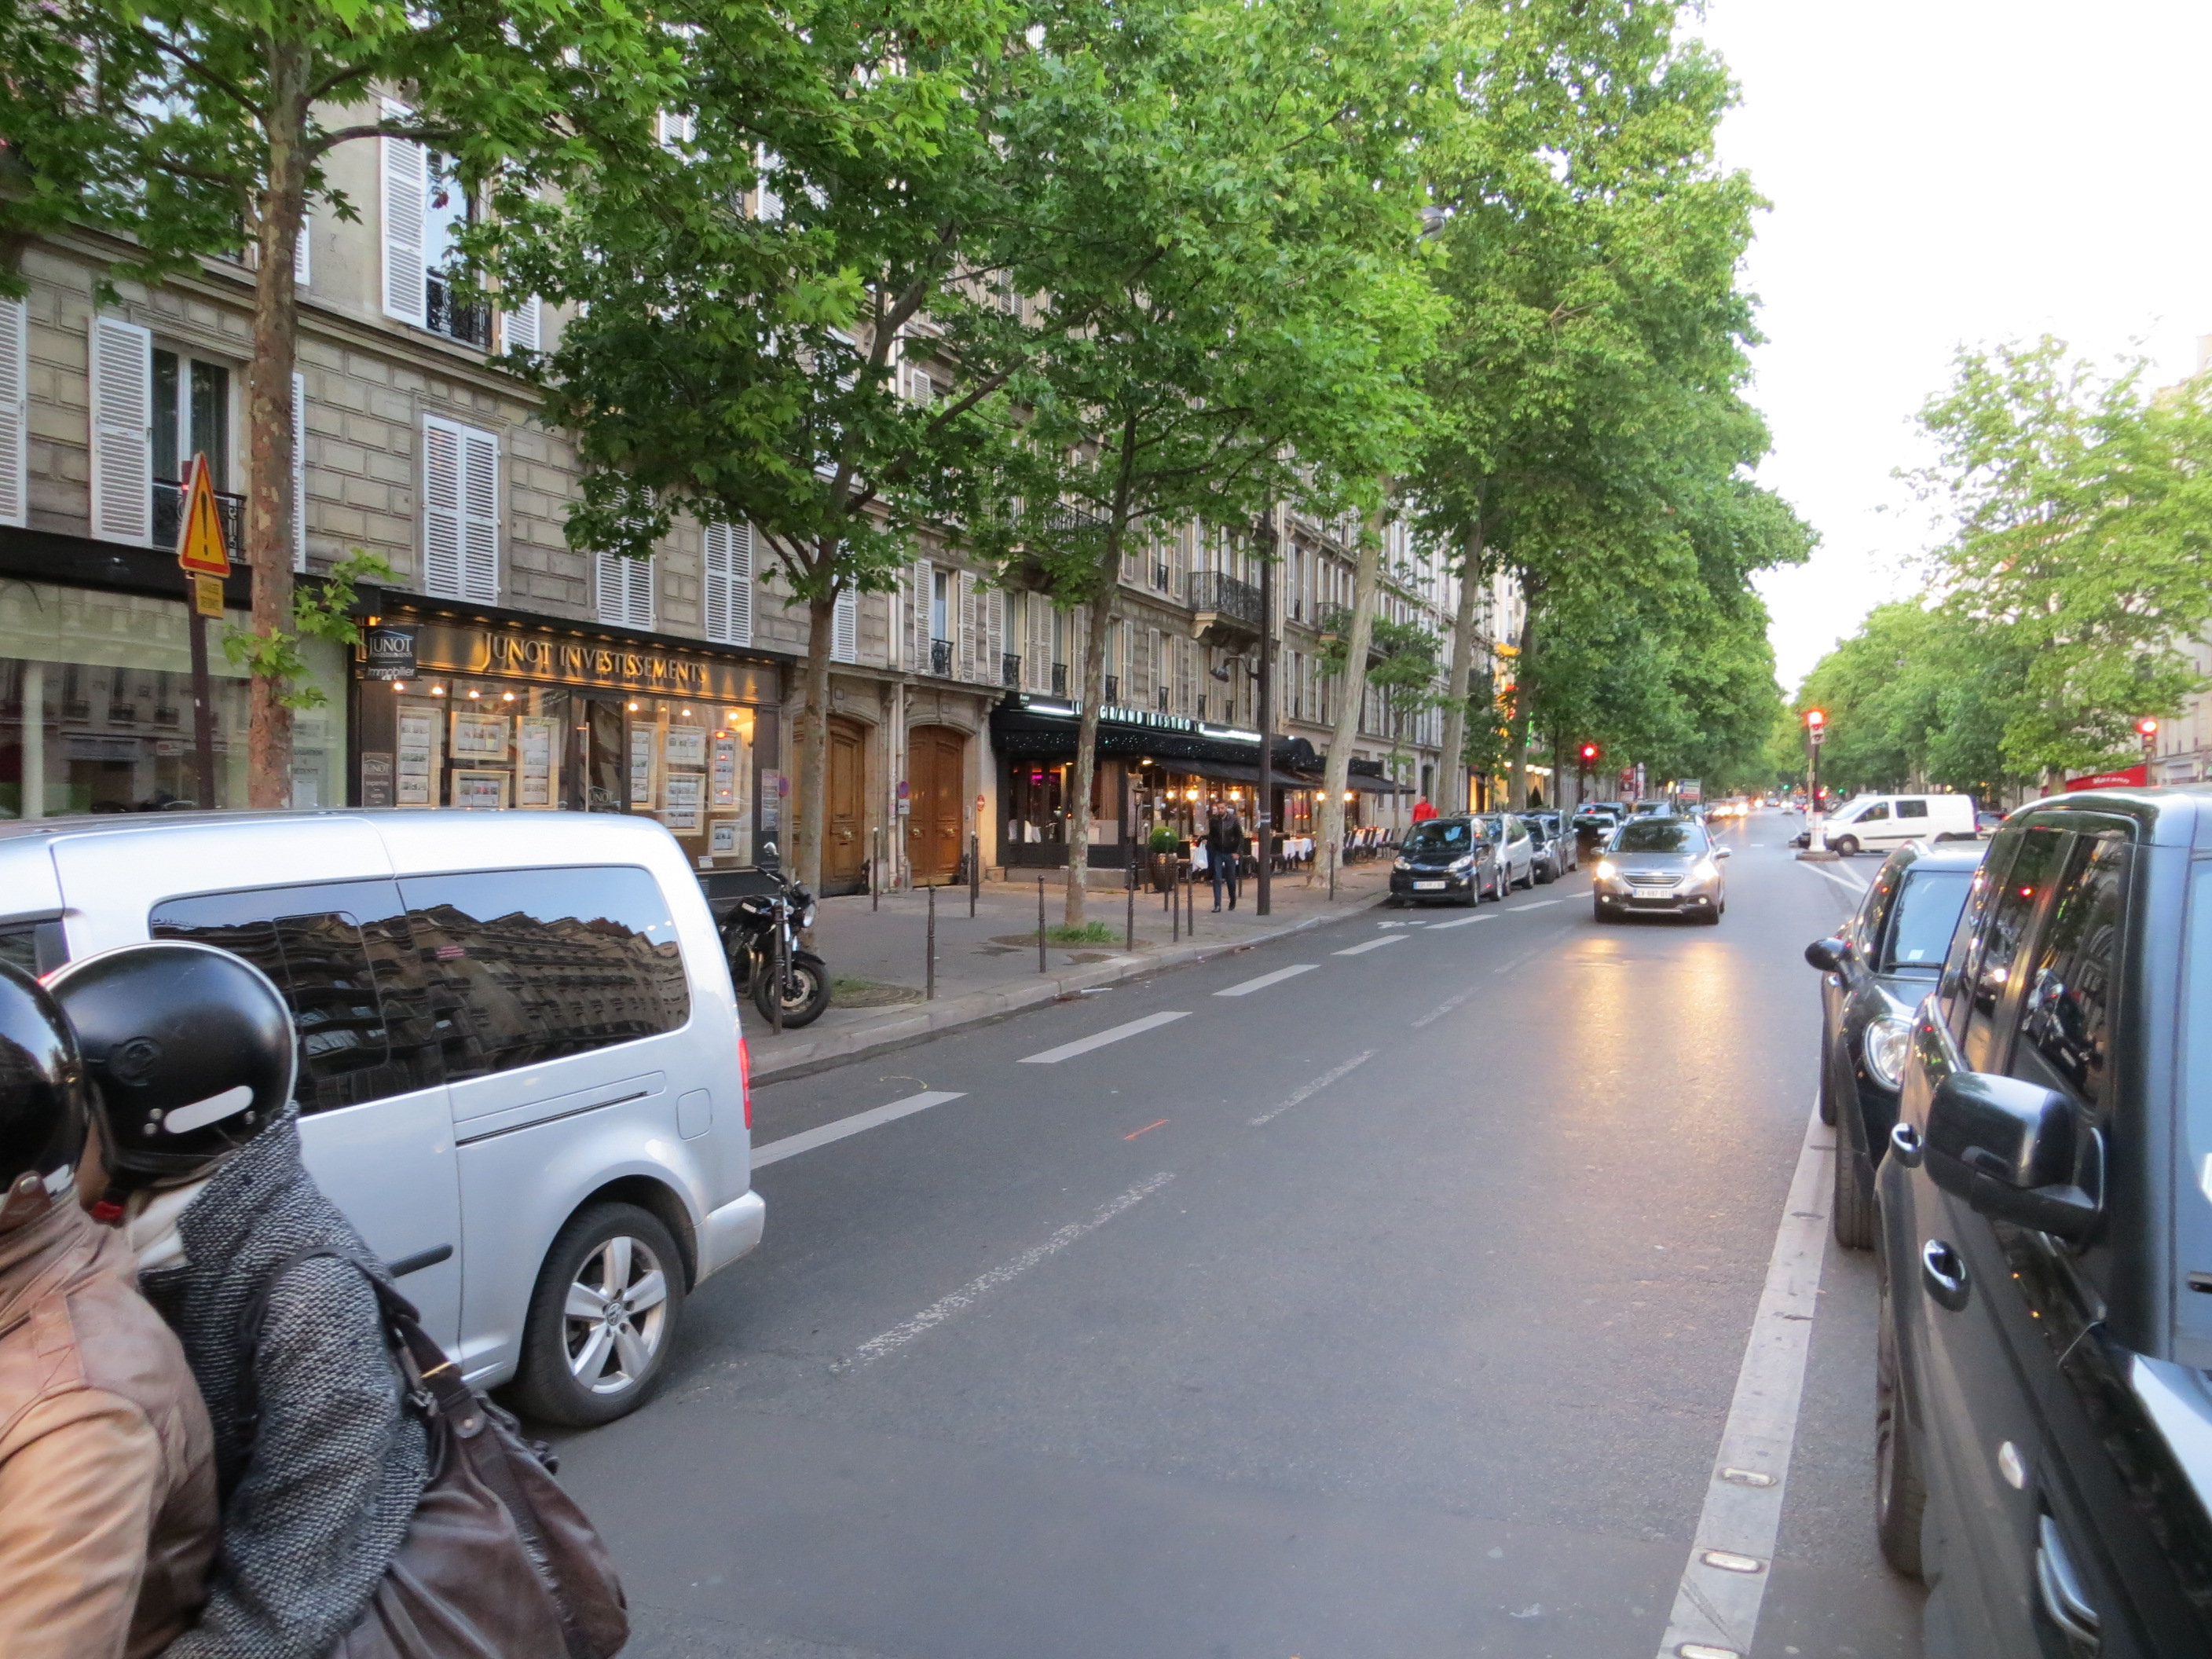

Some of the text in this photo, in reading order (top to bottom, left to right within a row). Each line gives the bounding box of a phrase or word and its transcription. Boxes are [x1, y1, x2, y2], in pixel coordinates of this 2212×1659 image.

[369, 638, 412, 657] JUNOT
[482, 632, 706, 683] JUNOT INVESTISSEMENTS
[1099, 705, 1142, 725] GRAND
